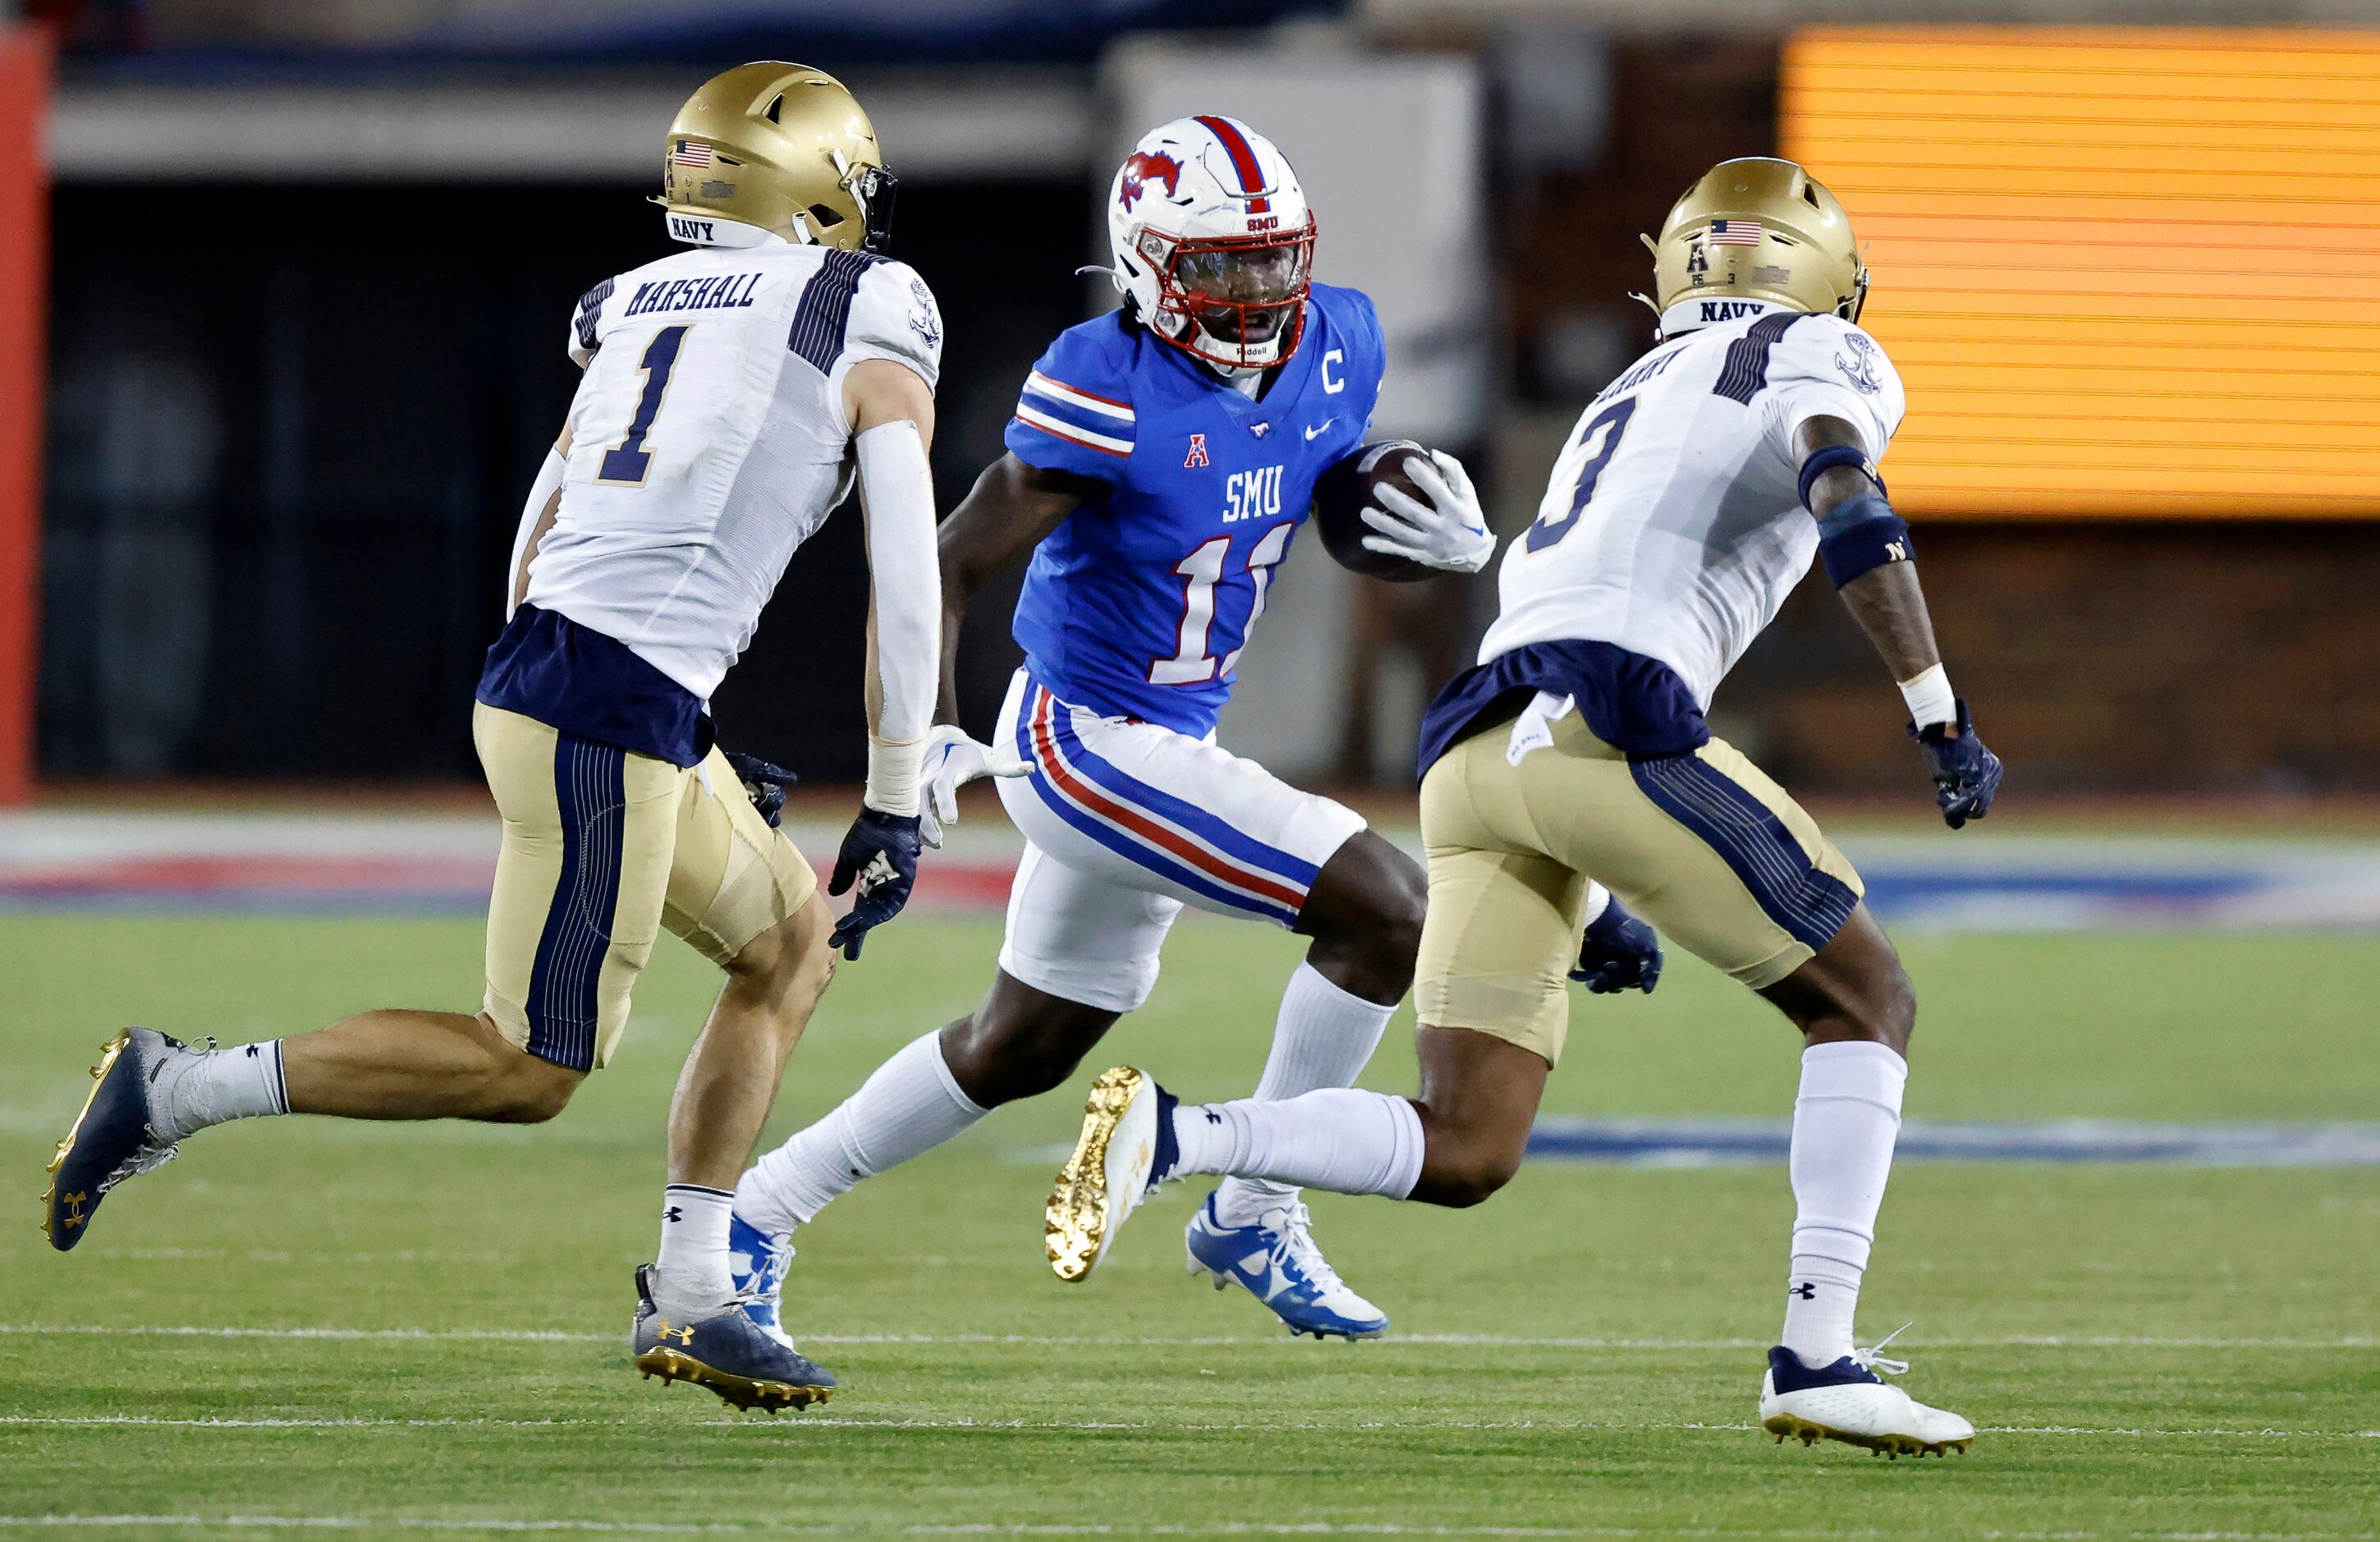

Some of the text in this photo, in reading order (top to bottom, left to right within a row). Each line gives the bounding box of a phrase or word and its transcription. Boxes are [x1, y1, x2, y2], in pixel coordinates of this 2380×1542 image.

[671, 217, 713, 241] NAVY
[1247, 215, 1278, 232] SMU
[624, 273, 764, 318] MARSHALL
[1727, 273, 1736, 285] 3
[1700, 301, 1764, 322] NAVY
[1236, 346, 1267, 356] Rddell
[1321, 348, 1345, 395] C
[592, 324, 696, 489] 1
[1184, 433, 1210, 469] A
[1222, 464, 1284, 523] SMU
[1524, 394, 1640, 559] 3
